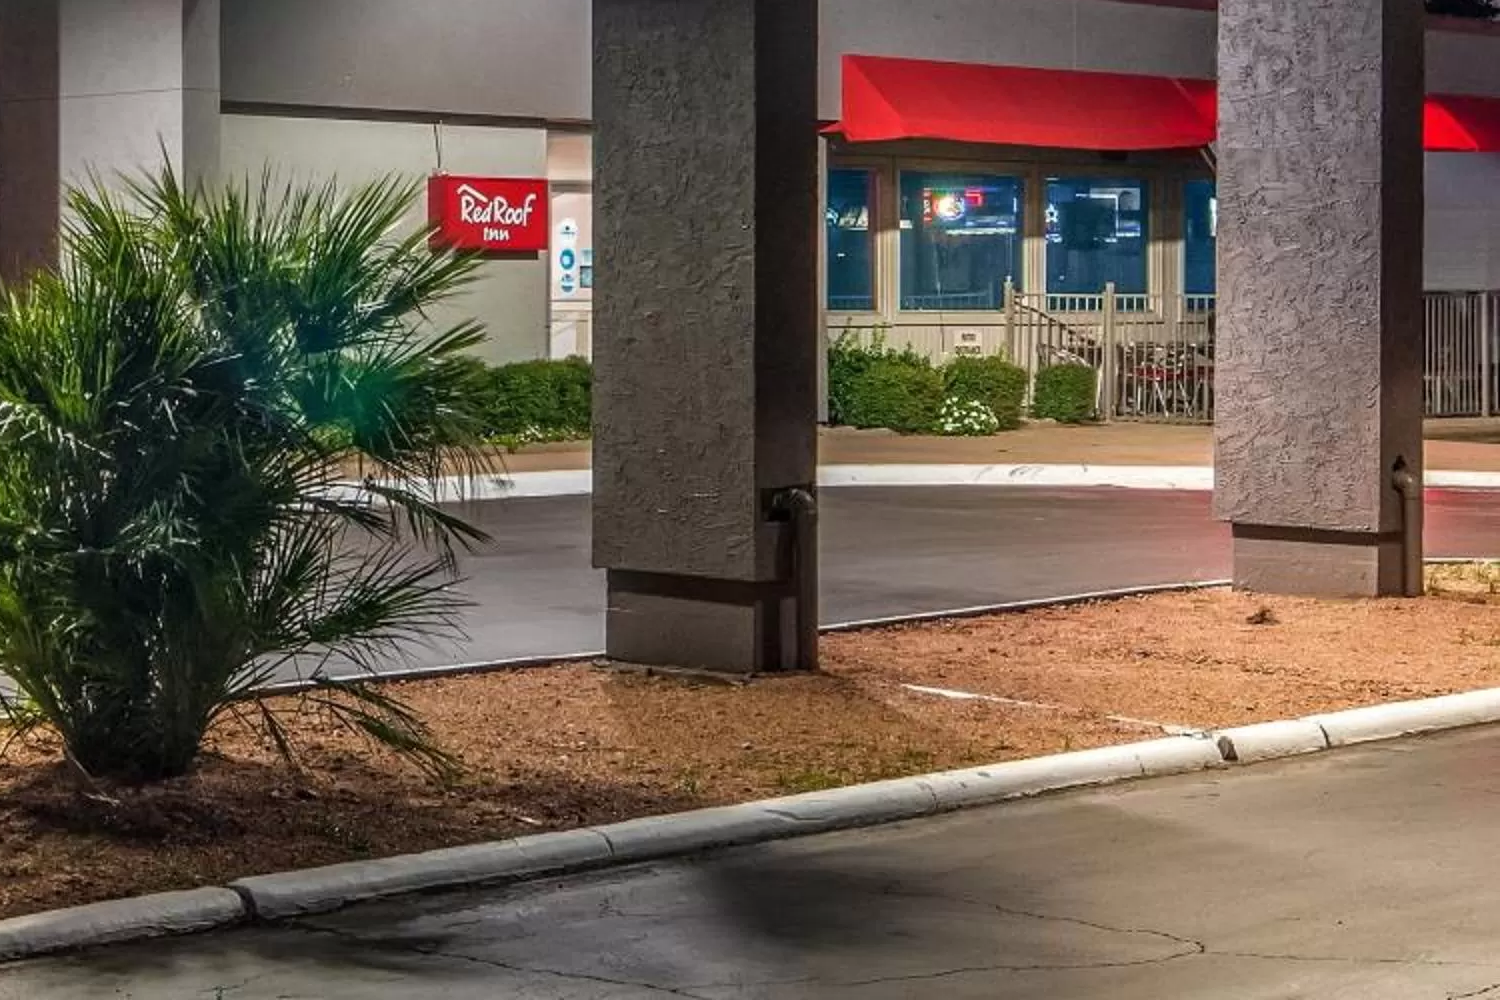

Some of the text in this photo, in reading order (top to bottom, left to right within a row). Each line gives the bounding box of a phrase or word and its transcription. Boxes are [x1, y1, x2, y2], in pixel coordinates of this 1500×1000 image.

[460, 193, 537, 227] Red Roof
[483, 226, 510, 241] Inn
